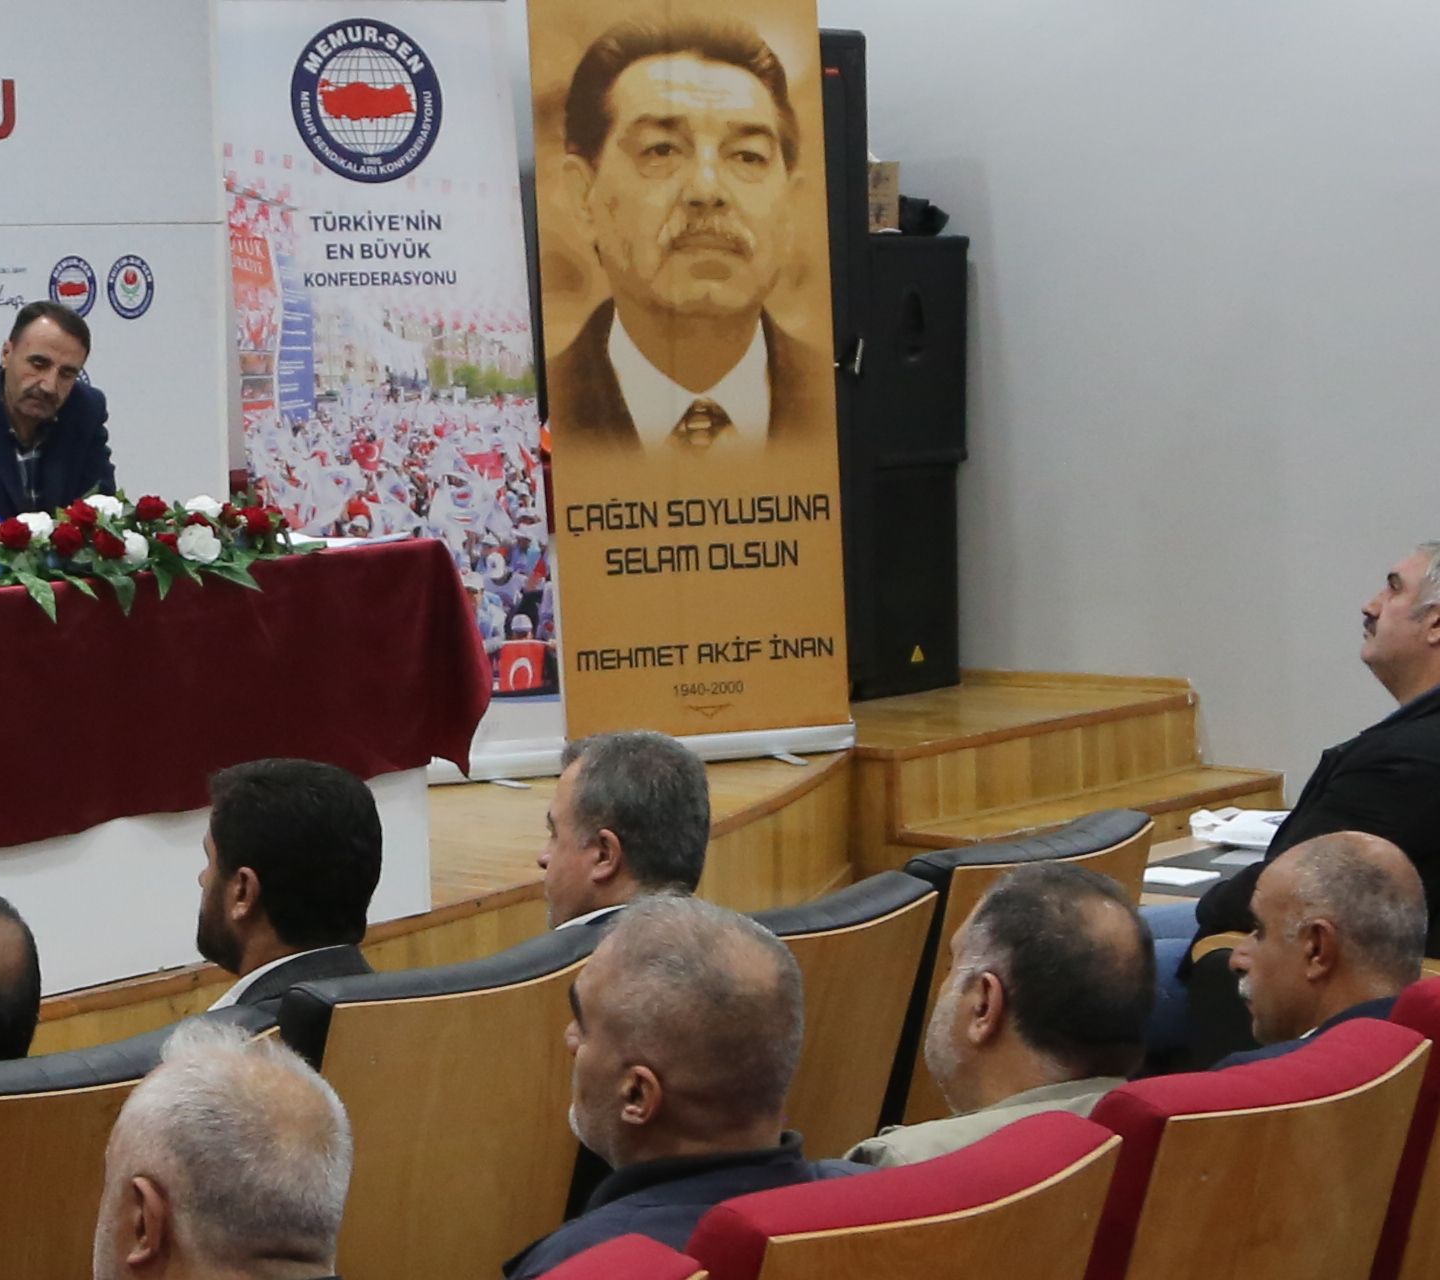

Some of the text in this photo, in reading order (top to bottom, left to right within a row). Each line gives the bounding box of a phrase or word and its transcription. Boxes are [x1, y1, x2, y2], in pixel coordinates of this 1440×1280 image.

[303, 25, 425, 75] MEMUR-SEN
[300, 90, 318, 136] MEMUR
[379, 90, 434, 175] KONFEDERASYONU
[309, 210, 442, 232] TÜRKİYE'NİN
[326, 238, 431, 260] EN BÜYÜK
[304, 270, 457, 287] KONFEDERASYONU
[567, 493, 830, 537] ÇAĞIN SOYLUSUNA
[606, 540, 799, 576] SELAM OLSUN
[577, 633, 834, 671] MEHMET AKİF İNAN
[673, 680, 744, 697] 1940-2000
